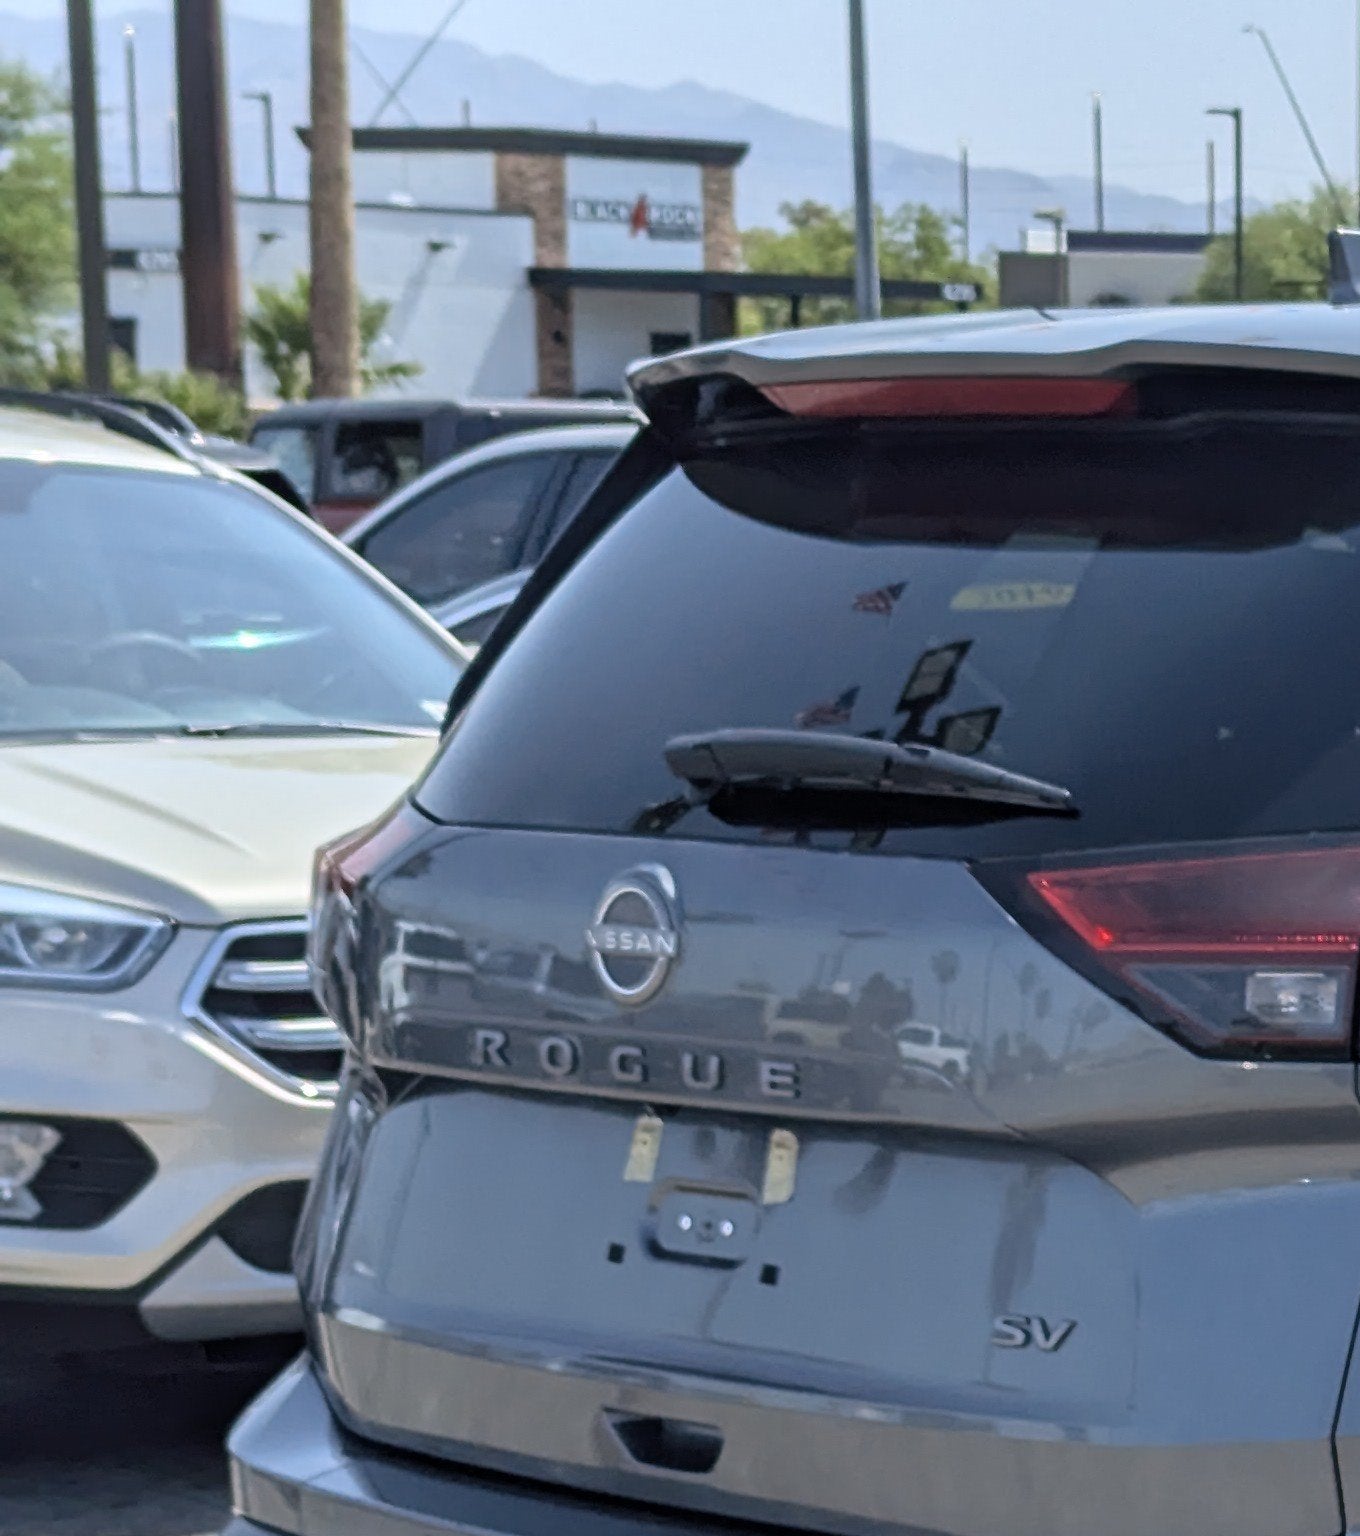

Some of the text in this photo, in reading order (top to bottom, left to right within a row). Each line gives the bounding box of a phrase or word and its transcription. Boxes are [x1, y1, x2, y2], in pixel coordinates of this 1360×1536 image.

[584, 928, 677, 954] NSSAN
[472, 1028, 800, 1099] ROGUE
[990, 1315, 1078, 1352] SV
